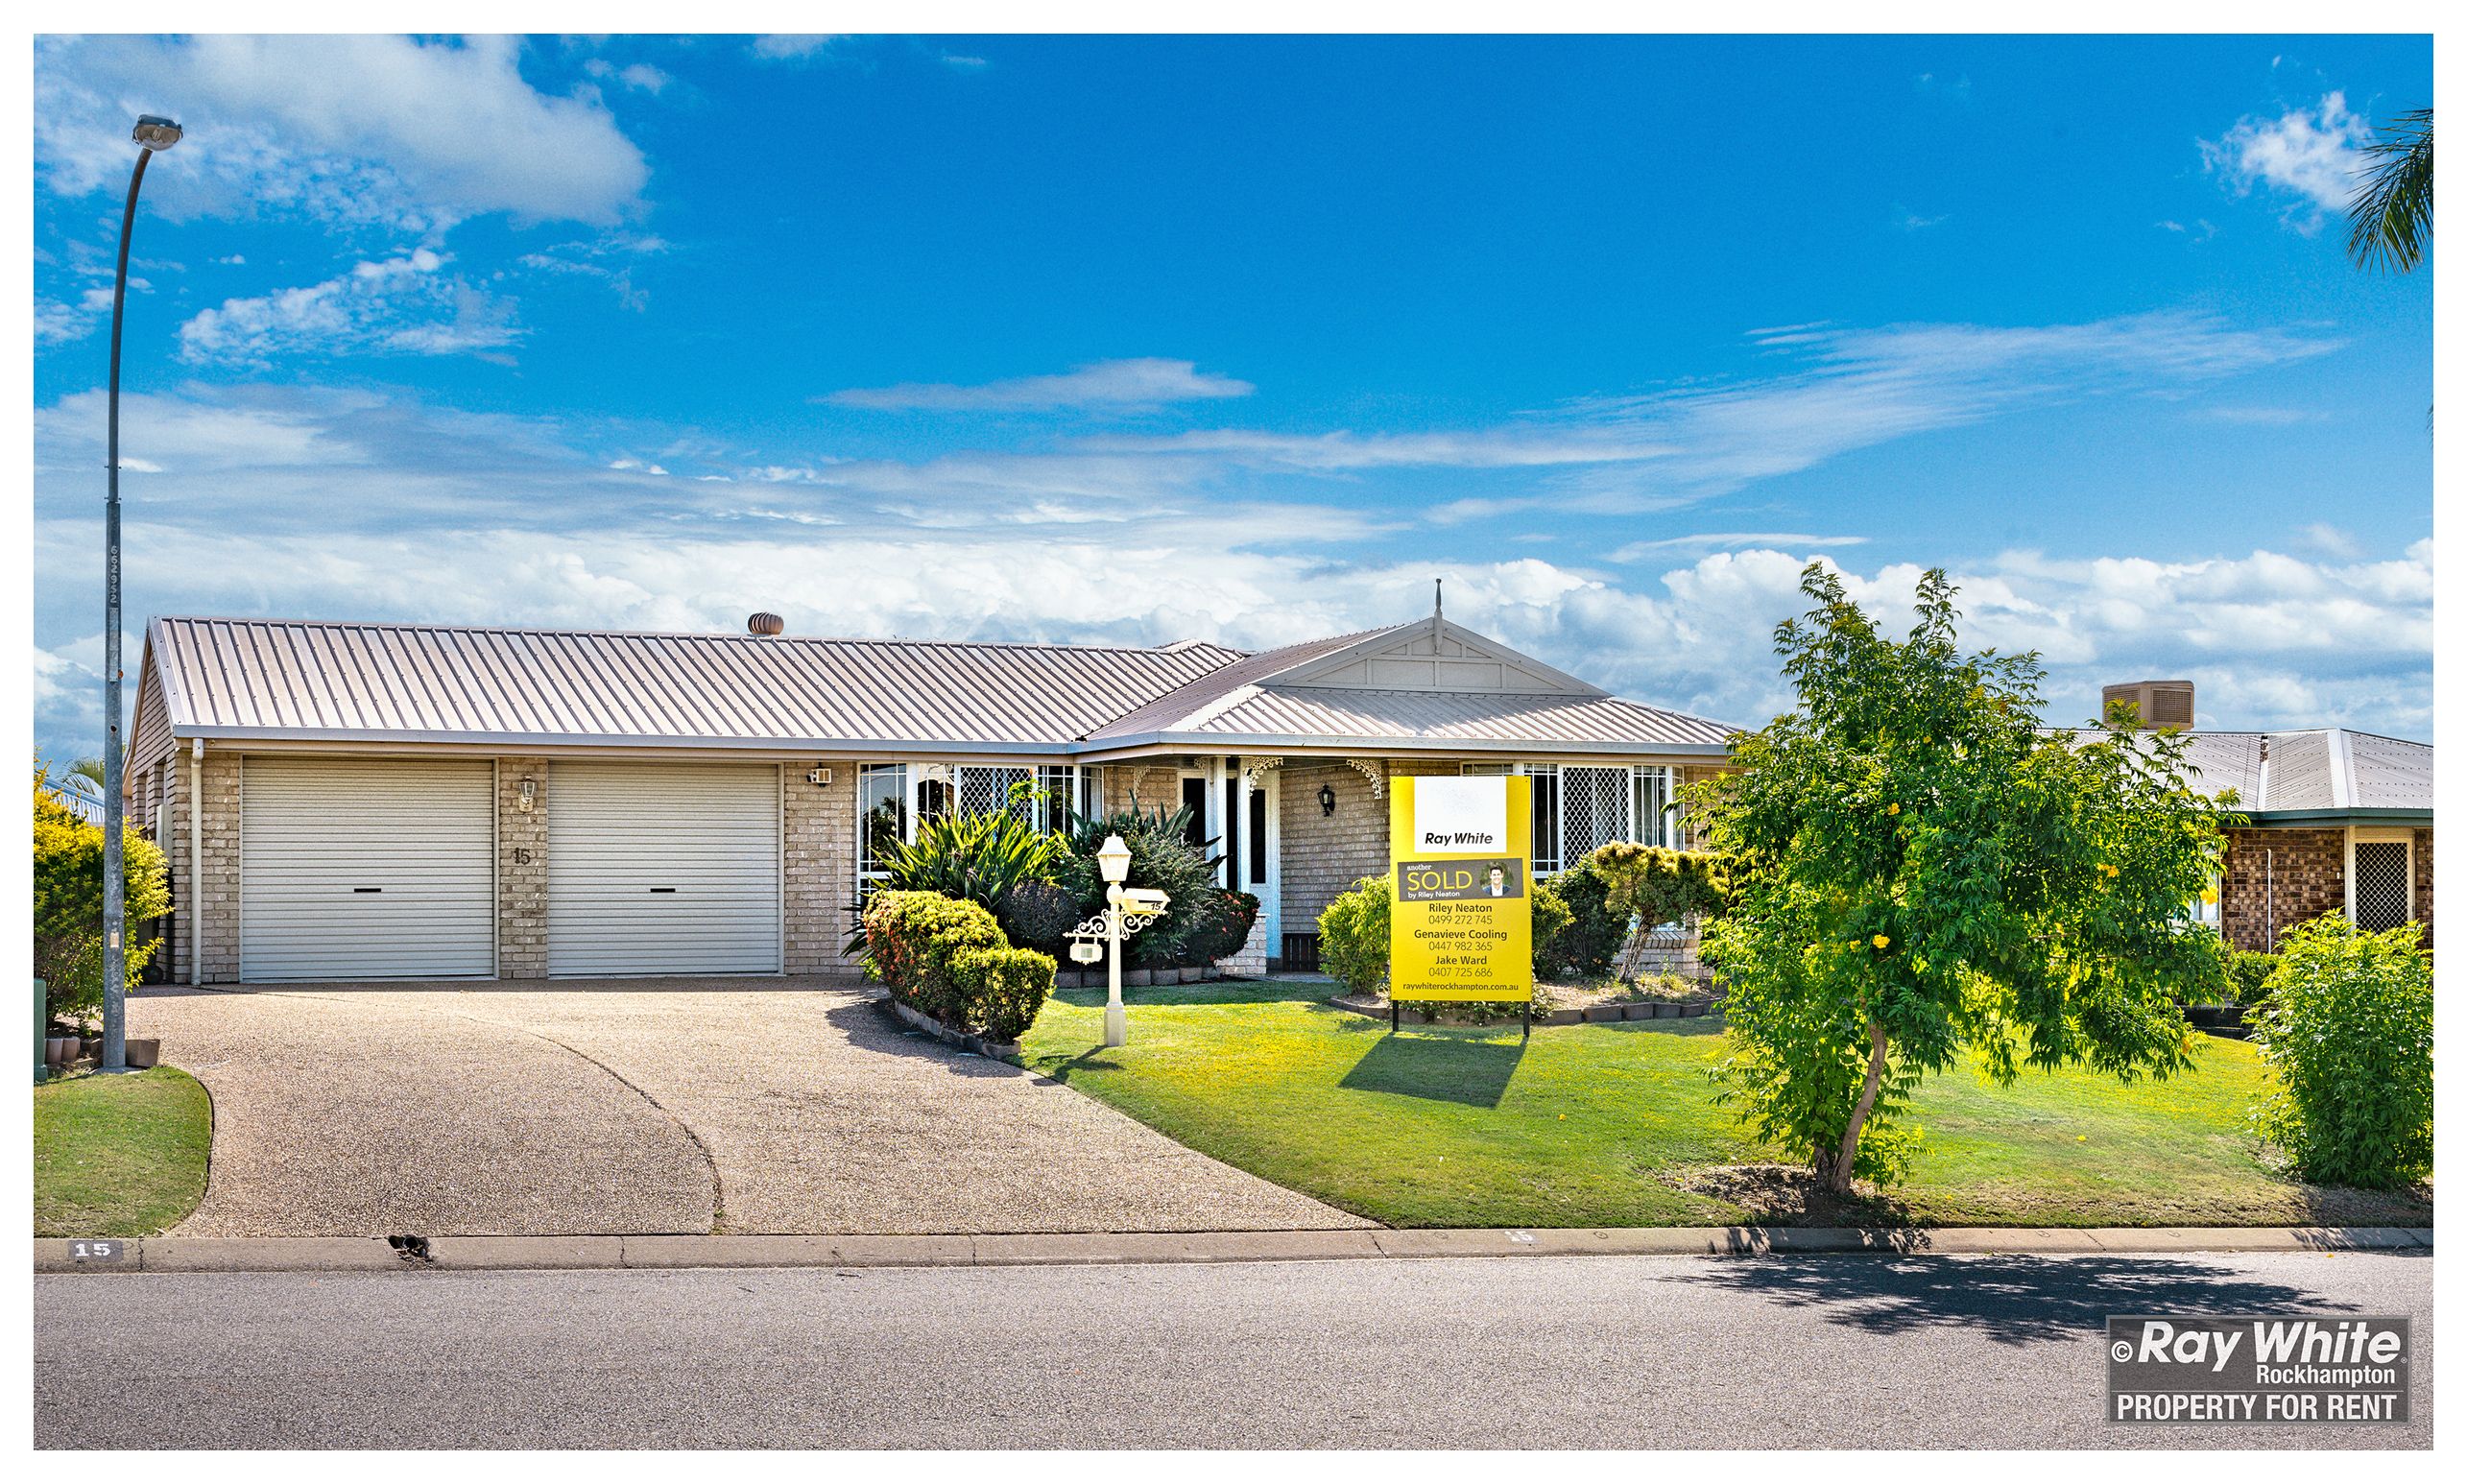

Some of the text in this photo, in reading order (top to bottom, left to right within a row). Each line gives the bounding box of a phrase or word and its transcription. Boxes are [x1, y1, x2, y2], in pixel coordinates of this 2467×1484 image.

[1425, 832, 1494, 847] Ray White
[514, 847, 531, 865] 15
[1407, 871, 1473, 891] SOLD
[1407, 891, 1417, 899] by
[1418, 891, 1434, 899] Riley
[1150, 902, 1162, 911] 15
[1428, 903, 1493, 914] Riley Neaton
[1428, 915, 1493, 925] 0499 272 745
[1414, 929, 1508, 941] Genavieve Cooling
[1428, 941, 1493, 951] 0447 982 365
[1435, 955, 1487, 965] Jake Ward
[1428, 967, 1493, 977] 0407 725 686
[1402, 982, 1519, 992] raywhiterockhampton.com.au
[75, 1243, 110, 1257] 15
